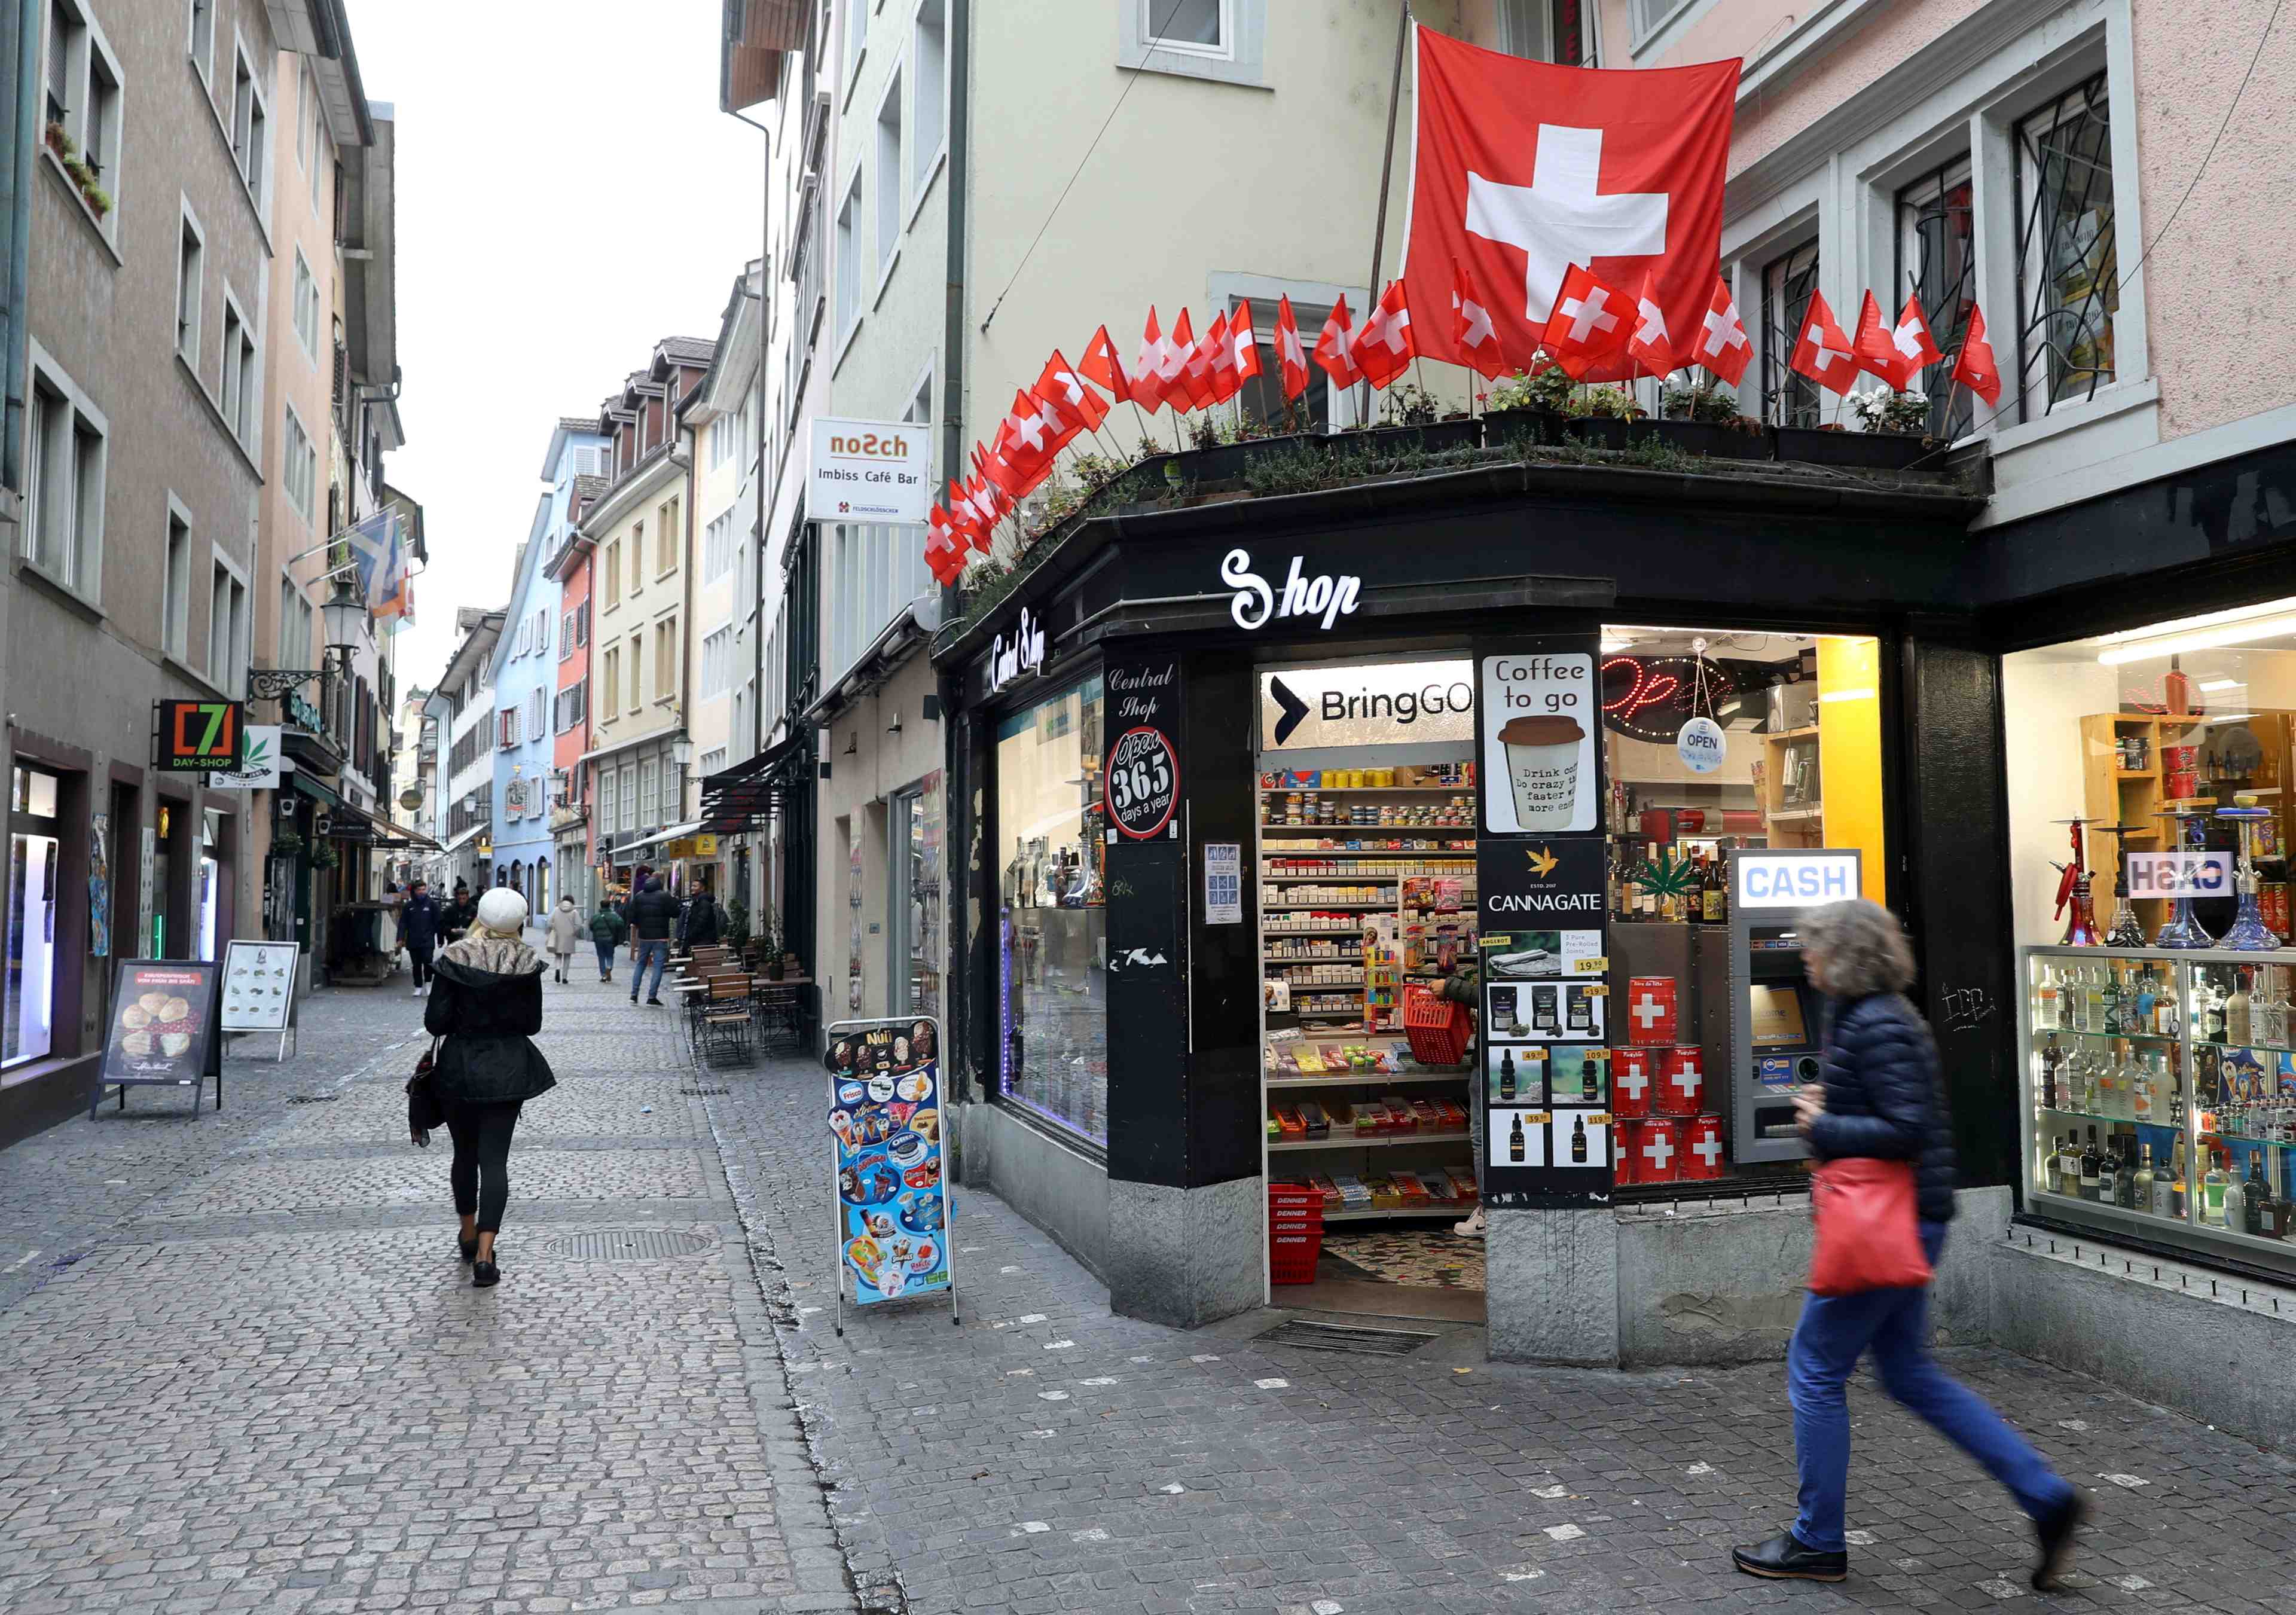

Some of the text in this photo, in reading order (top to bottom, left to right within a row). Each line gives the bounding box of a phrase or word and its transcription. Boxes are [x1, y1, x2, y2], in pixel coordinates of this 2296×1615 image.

[819, 468, 918, 484] Imbiss Café Bar
[1220, 549, 1361, 630] Shop
[1109, 664, 1174, 691] Central
[1496, 658, 1585, 682] Coffee
[1119, 696, 1161, 722] Shop
[1322, 683, 1473, 723] BringGO
[1504, 686, 1577, 712] to go
[1116, 729, 1161, 768] Open
[1687, 734, 1717, 749] OPEN
[173, 758, 231, 767] DAY-SHOP
[1523, 768, 1559, 777] Drink
[1113, 750, 1168, 808] 365
[1516, 779, 1527, 787] Do
[1532, 780, 1564, 789] crazy
[1122, 794, 1170, 822] days a year
[1527, 792, 1564, 800] faster
[1746, 865, 1846, 897] CASH
[1488, 894, 1602, 911] CANNAGATE
[843, 1090, 862, 1100] Frisco
